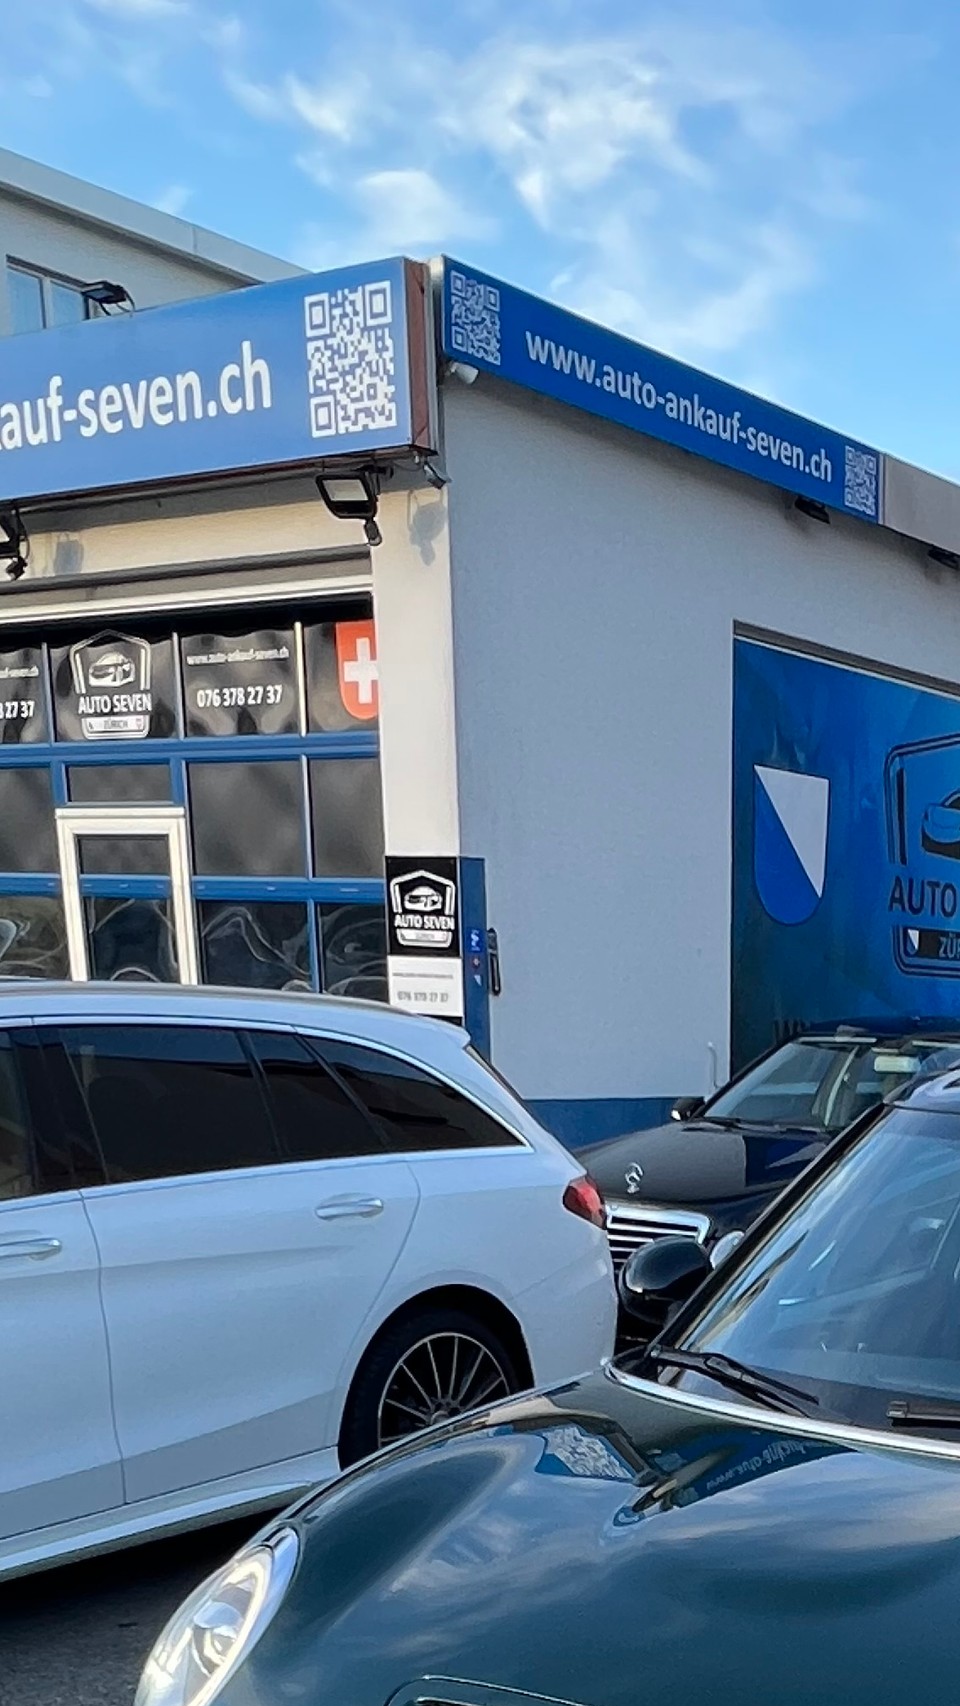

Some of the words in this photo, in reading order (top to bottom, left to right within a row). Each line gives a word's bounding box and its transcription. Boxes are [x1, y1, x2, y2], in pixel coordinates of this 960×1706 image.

[0, 340, 272, 450] auf-seven.ch
[525, 330, 832, 483] www.auto-ankauf-seven.ch
[78, 694, 112, 715] AUTO
[112, 693, 153, 713] SEVEN
[196, 688, 222, 708] 076
[222, 687, 246, 707] 378
[247, 685, 264, 705] 27
[266, 684, 283, 704] 37
[20, 700, 36, 719] 37
[888, 875, 958, 919] AUTO
[394, 914, 422, 928] AUTO
[423, 915, 456, 930] SEVEN
